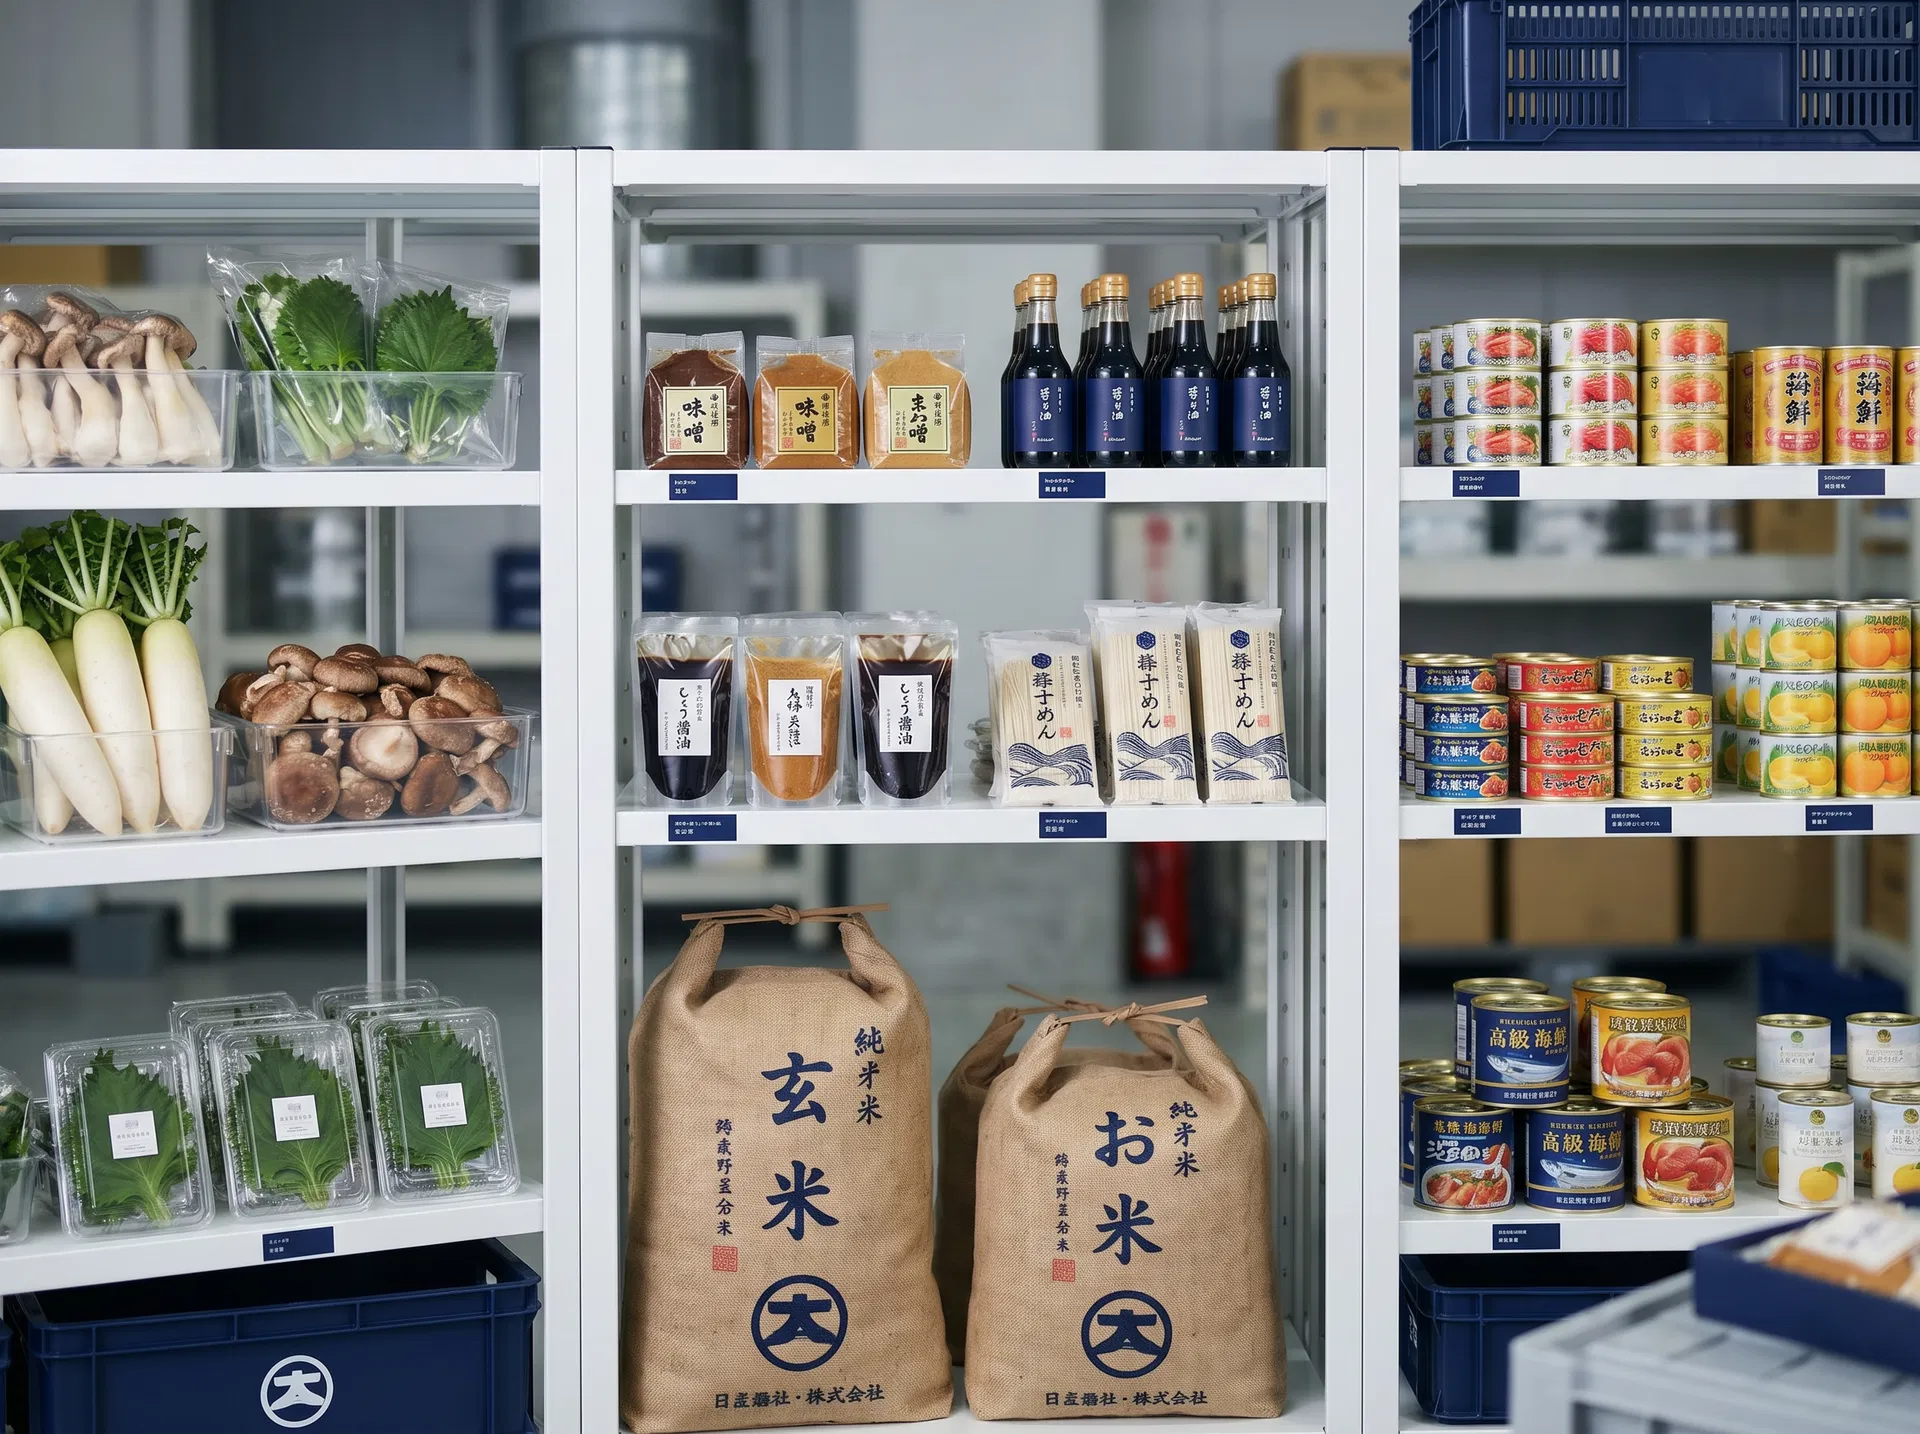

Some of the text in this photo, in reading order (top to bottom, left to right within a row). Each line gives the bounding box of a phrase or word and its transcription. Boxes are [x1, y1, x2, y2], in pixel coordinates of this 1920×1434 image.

[682, 397, 707, 444] 味噌
[794, 396, 820, 443] 味噌
[761, 1052, 839, 1241] 玄米
[1092, 1111, 1163, 1265] お米
